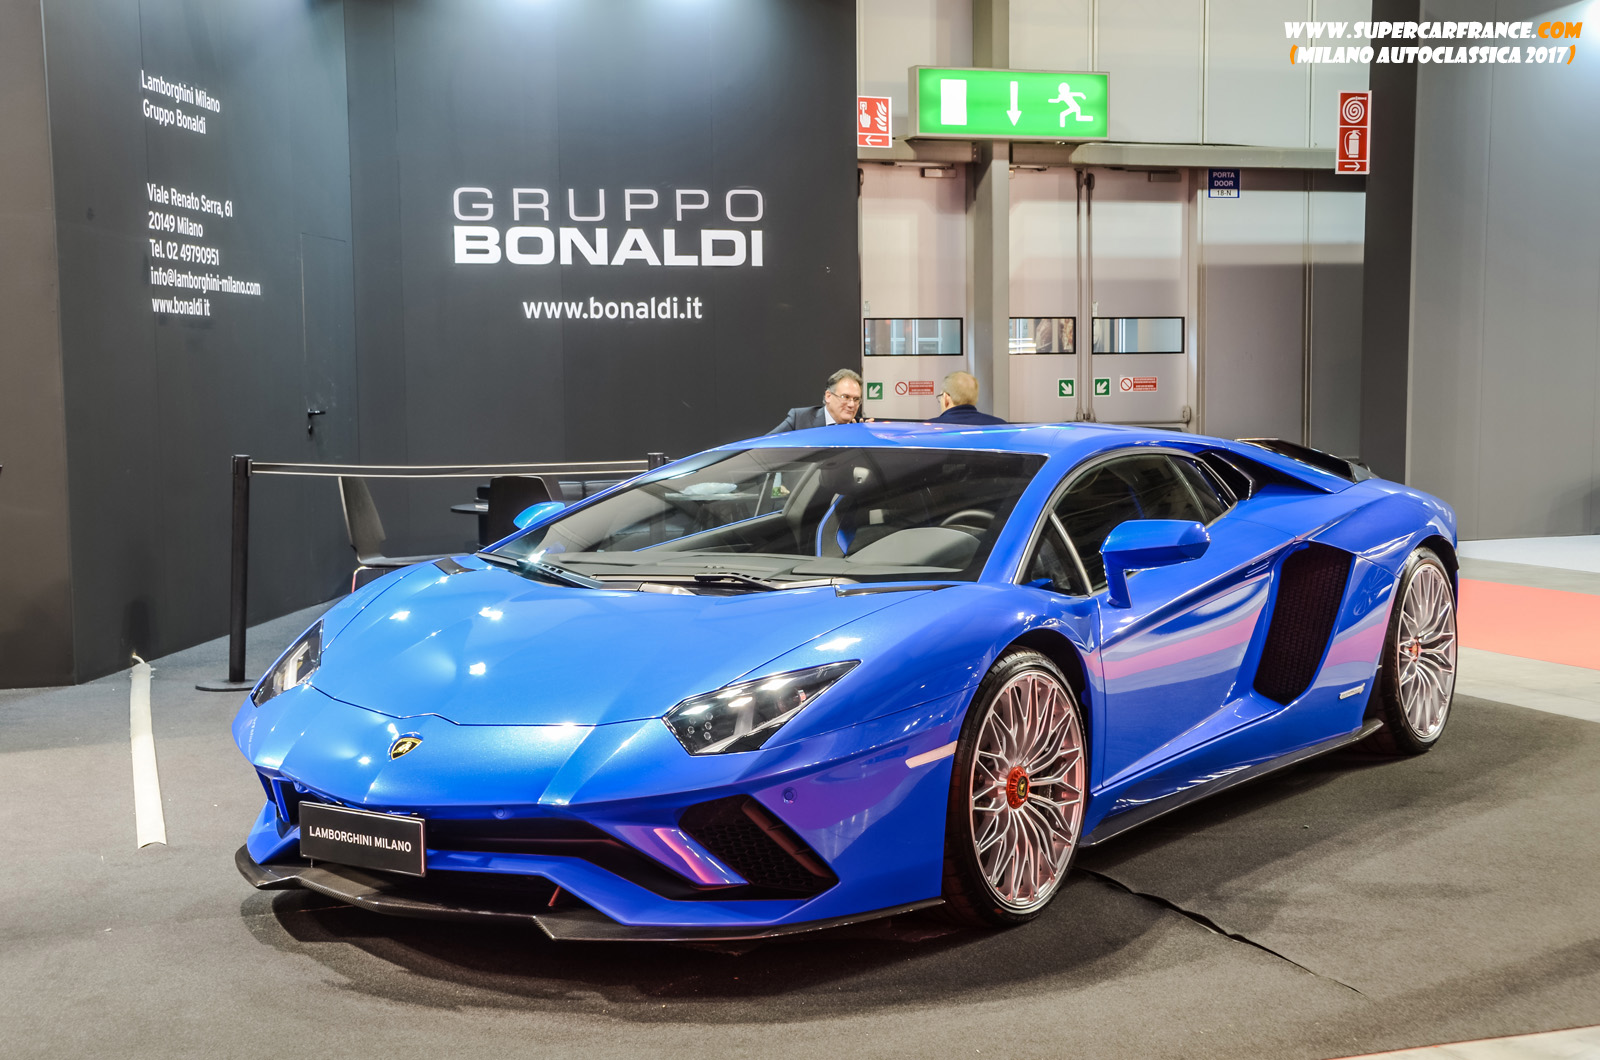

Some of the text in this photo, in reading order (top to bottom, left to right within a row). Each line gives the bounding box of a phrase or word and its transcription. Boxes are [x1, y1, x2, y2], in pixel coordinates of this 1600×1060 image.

[141, 69, 221, 113] Lamborghini Milano
[143, 98, 206, 134] Gruppo Bonaldi
[146, 182, 233, 218] Viale Renato Serra, 61
[453, 187, 764, 222] GRUPPO
[148, 210, 204, 238] 20149 Milano
[149, 238, 220, 266] Tel. 02 49790951
[453, 225, 764, 267] BONALDI
[150, 265, 262, 295] info@lamborghini-milano.com
[522, 296, 703, 319] www.bonaldi.it
[309, 825, 412, 853] LAMBORGHINI MILANO
